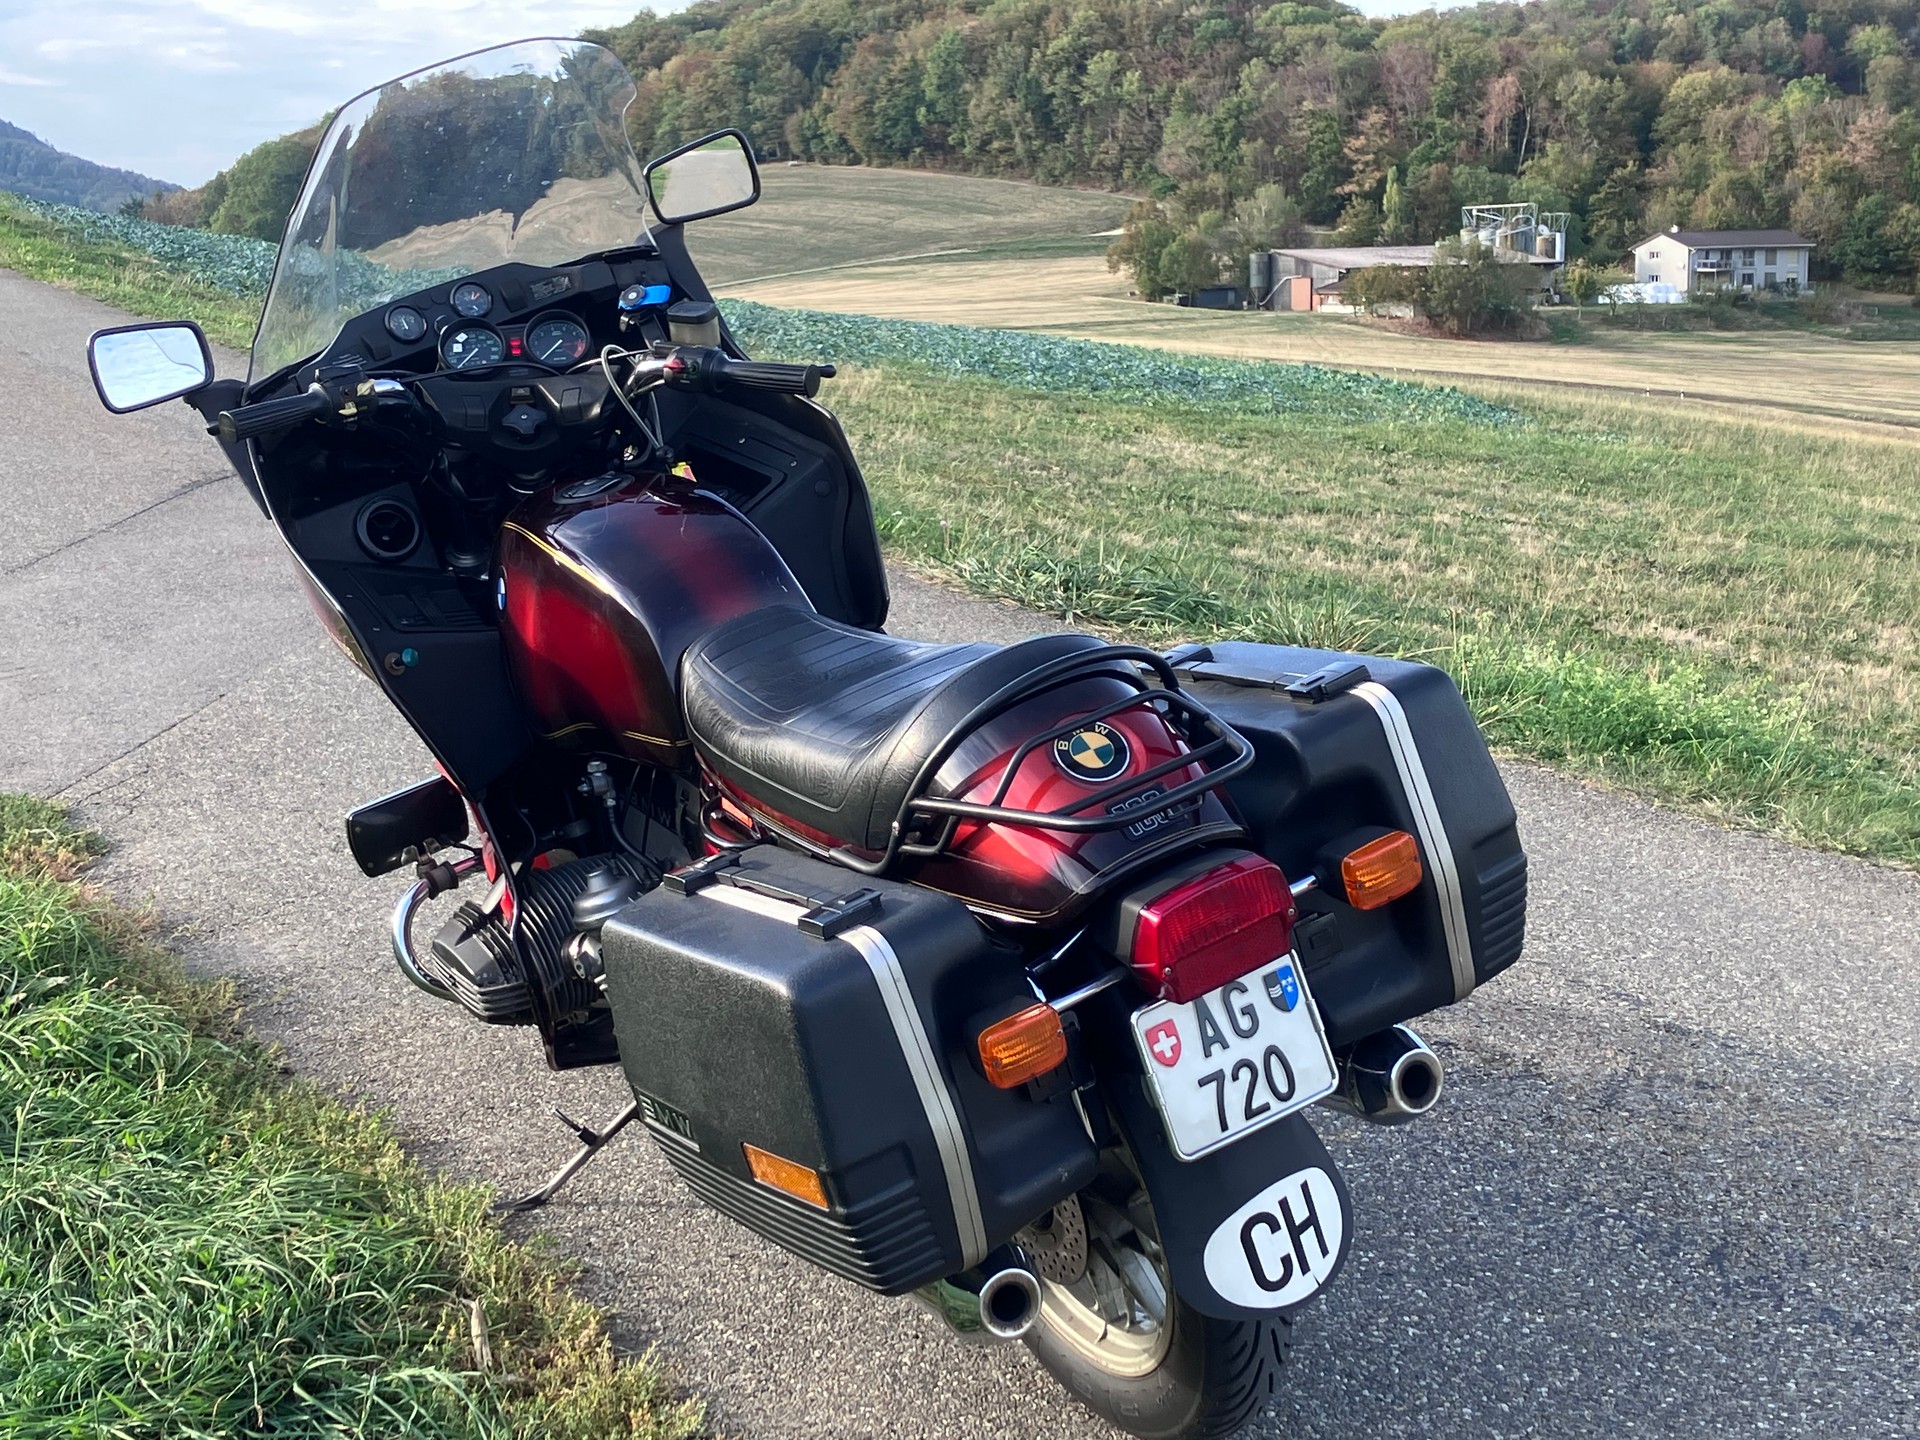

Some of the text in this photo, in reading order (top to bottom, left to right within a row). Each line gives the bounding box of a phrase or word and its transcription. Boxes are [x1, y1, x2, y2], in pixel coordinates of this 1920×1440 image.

[1193, 980, 1260, 1058] AG
[1198, 1044, 1296, 1133] 720
[1239, 1179, 1330, 1293] CH
